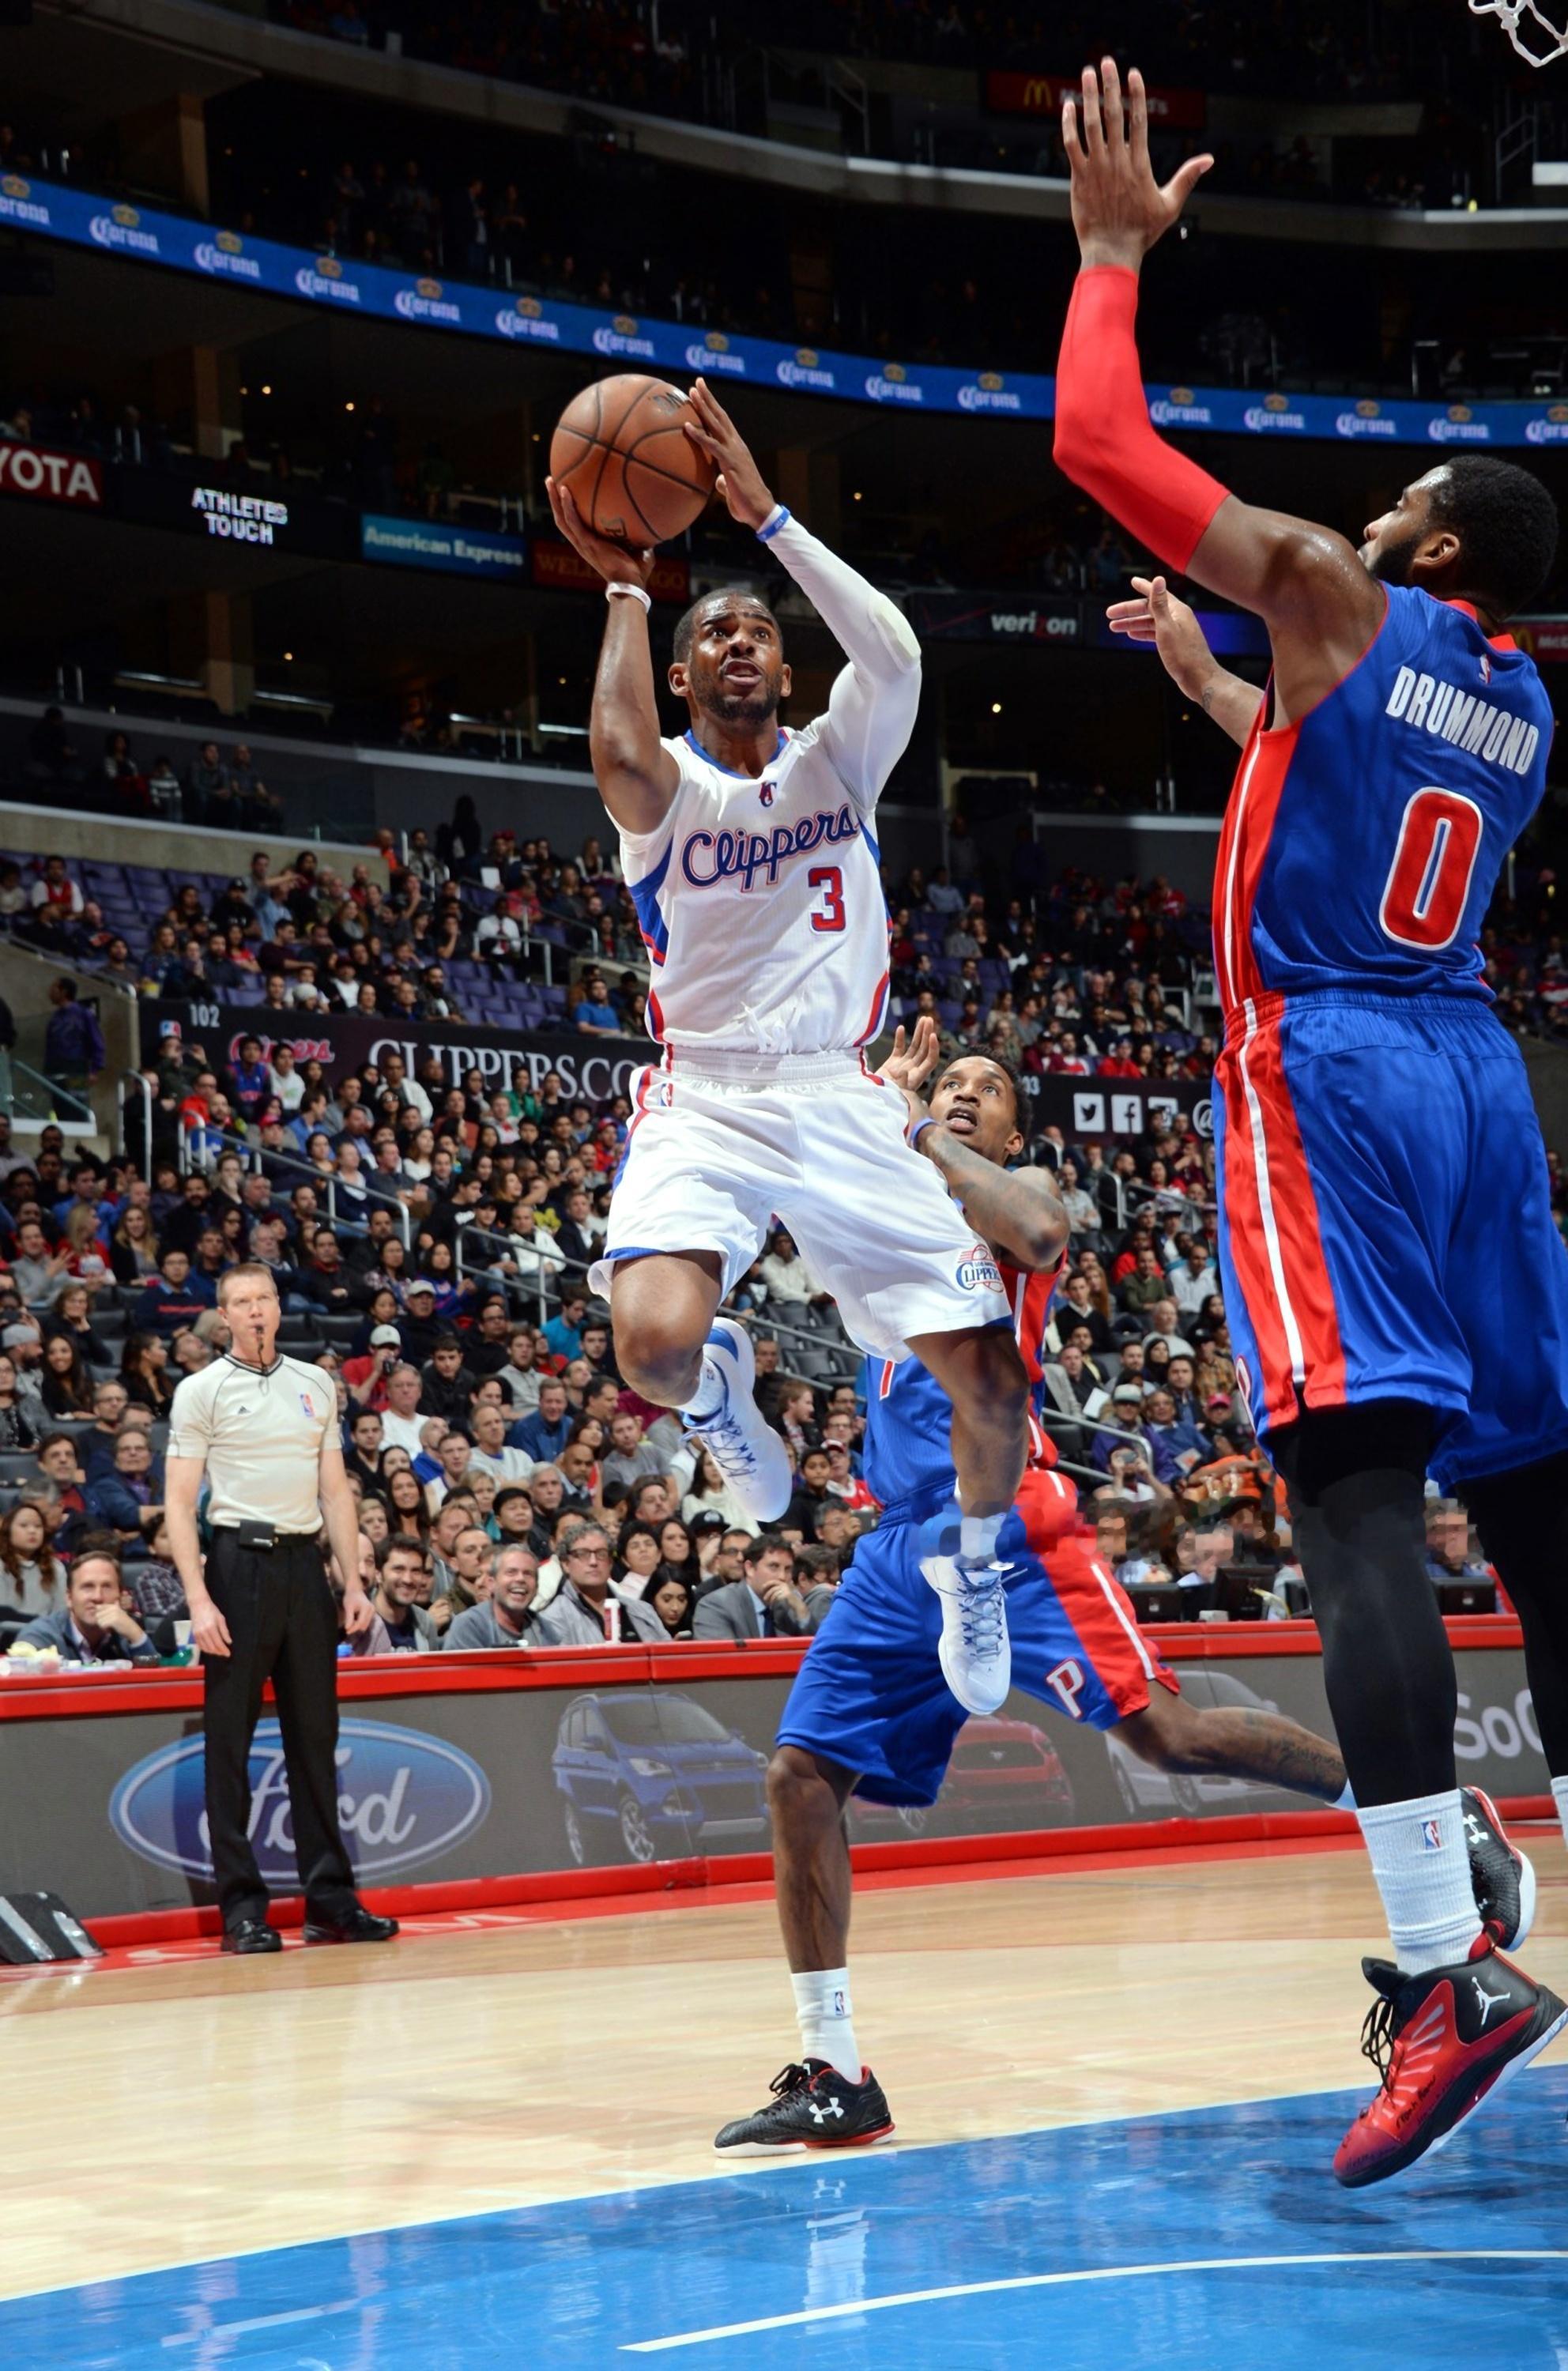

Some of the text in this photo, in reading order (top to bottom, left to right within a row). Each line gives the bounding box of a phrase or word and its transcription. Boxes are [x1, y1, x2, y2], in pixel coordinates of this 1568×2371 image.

[89, 218, 159, 252] Corona
[194, 245, 260, 278] Corona
[296, 270, 360, 302] Corona
[394, 292, 460, 322] Corona
[496, 311, 559, 340] Corona
[593, 330, 654, 356] Corona
[685, 346, 744, 372] Corona
[776, 363, 834, 388] Corona
[865, 378, 922, 401] Corona
[957, 388, 1020, 409] Corona
[1150, 402, 1211, 424] Corona
[1244, 409, 1304, 431] Corona
[1336, 415, 1396, 437] Corona
[1428, 420, 1489, 442] Corona
[204, 512, 274, 545] TOUCH
[364, 526, 524, 567] American Express
[990, 611, 1077, 637] verizon
[1385, 665, 1540, 775] DRUMMOND
[680, 803, 860, 893] Clippers
[1379, 786, 1483, 951] 0
[808, 865, 847, 935] 3
[190, 1004, 220, 1027] 102
[1046, 1657, 1085, 1720] P
